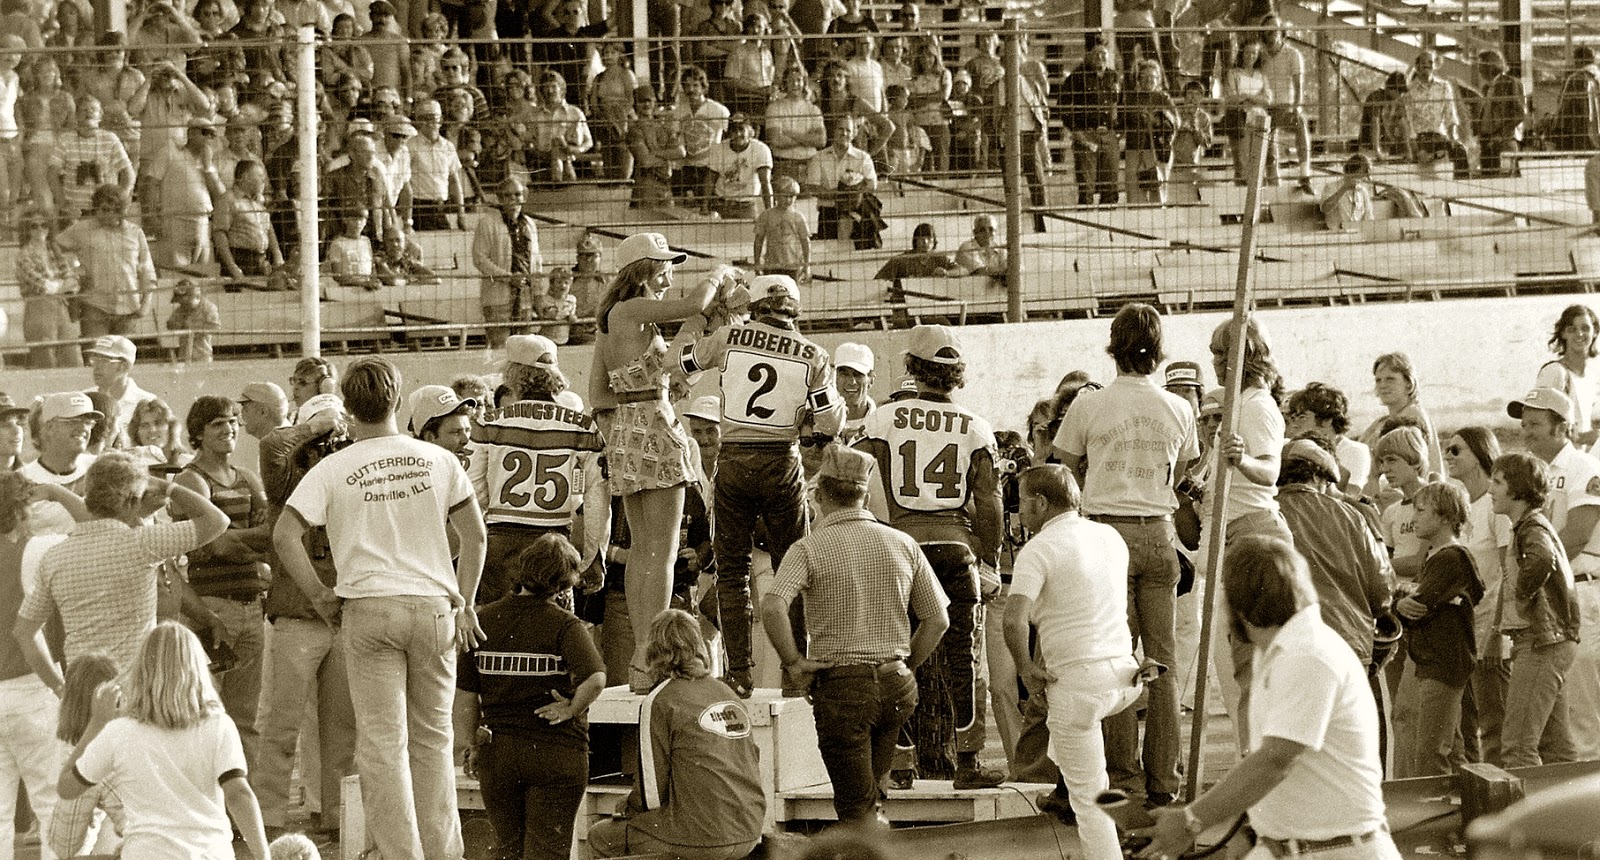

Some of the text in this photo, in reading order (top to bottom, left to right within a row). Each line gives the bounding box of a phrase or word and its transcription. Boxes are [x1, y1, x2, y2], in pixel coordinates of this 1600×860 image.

[726, 328, 816, 360] ROBERTS
[745, 362, 778, 419] 2
[483, 402, 593, 430] SPRINGSTEEN
[893, 406, 974, 435] SCOTT
[346, 456, 434, 486] GUTTERRIDGE
[359, 470, 431, 489] Harley-Davidson
[500, 450, 570, 511] 25
[898, 440, 962, 499] 14
